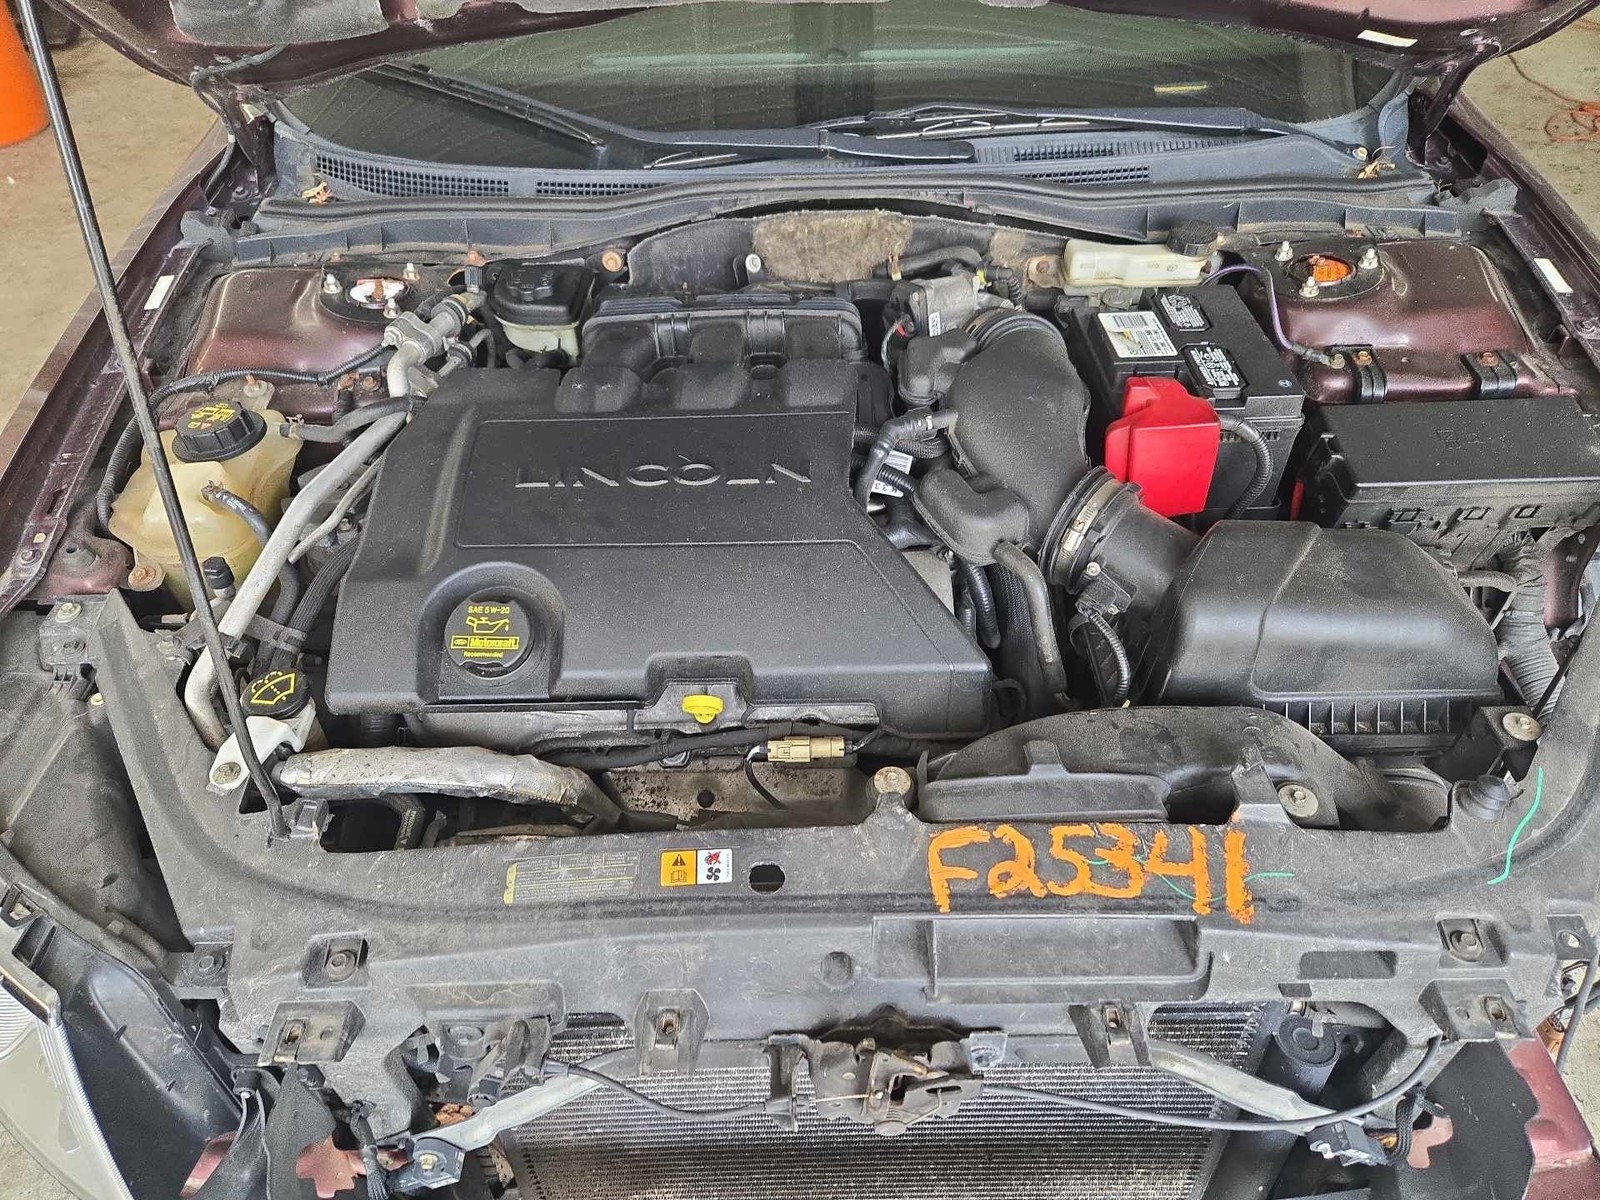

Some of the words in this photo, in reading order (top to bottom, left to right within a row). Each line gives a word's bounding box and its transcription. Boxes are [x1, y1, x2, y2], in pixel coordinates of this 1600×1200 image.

[514, 459, 812, 487] LINCOLN
[467, 605, 484, 614] SAE
[470, 637, 517, 649] Motorcraft
[927, 823, 1255, 925] F25341
